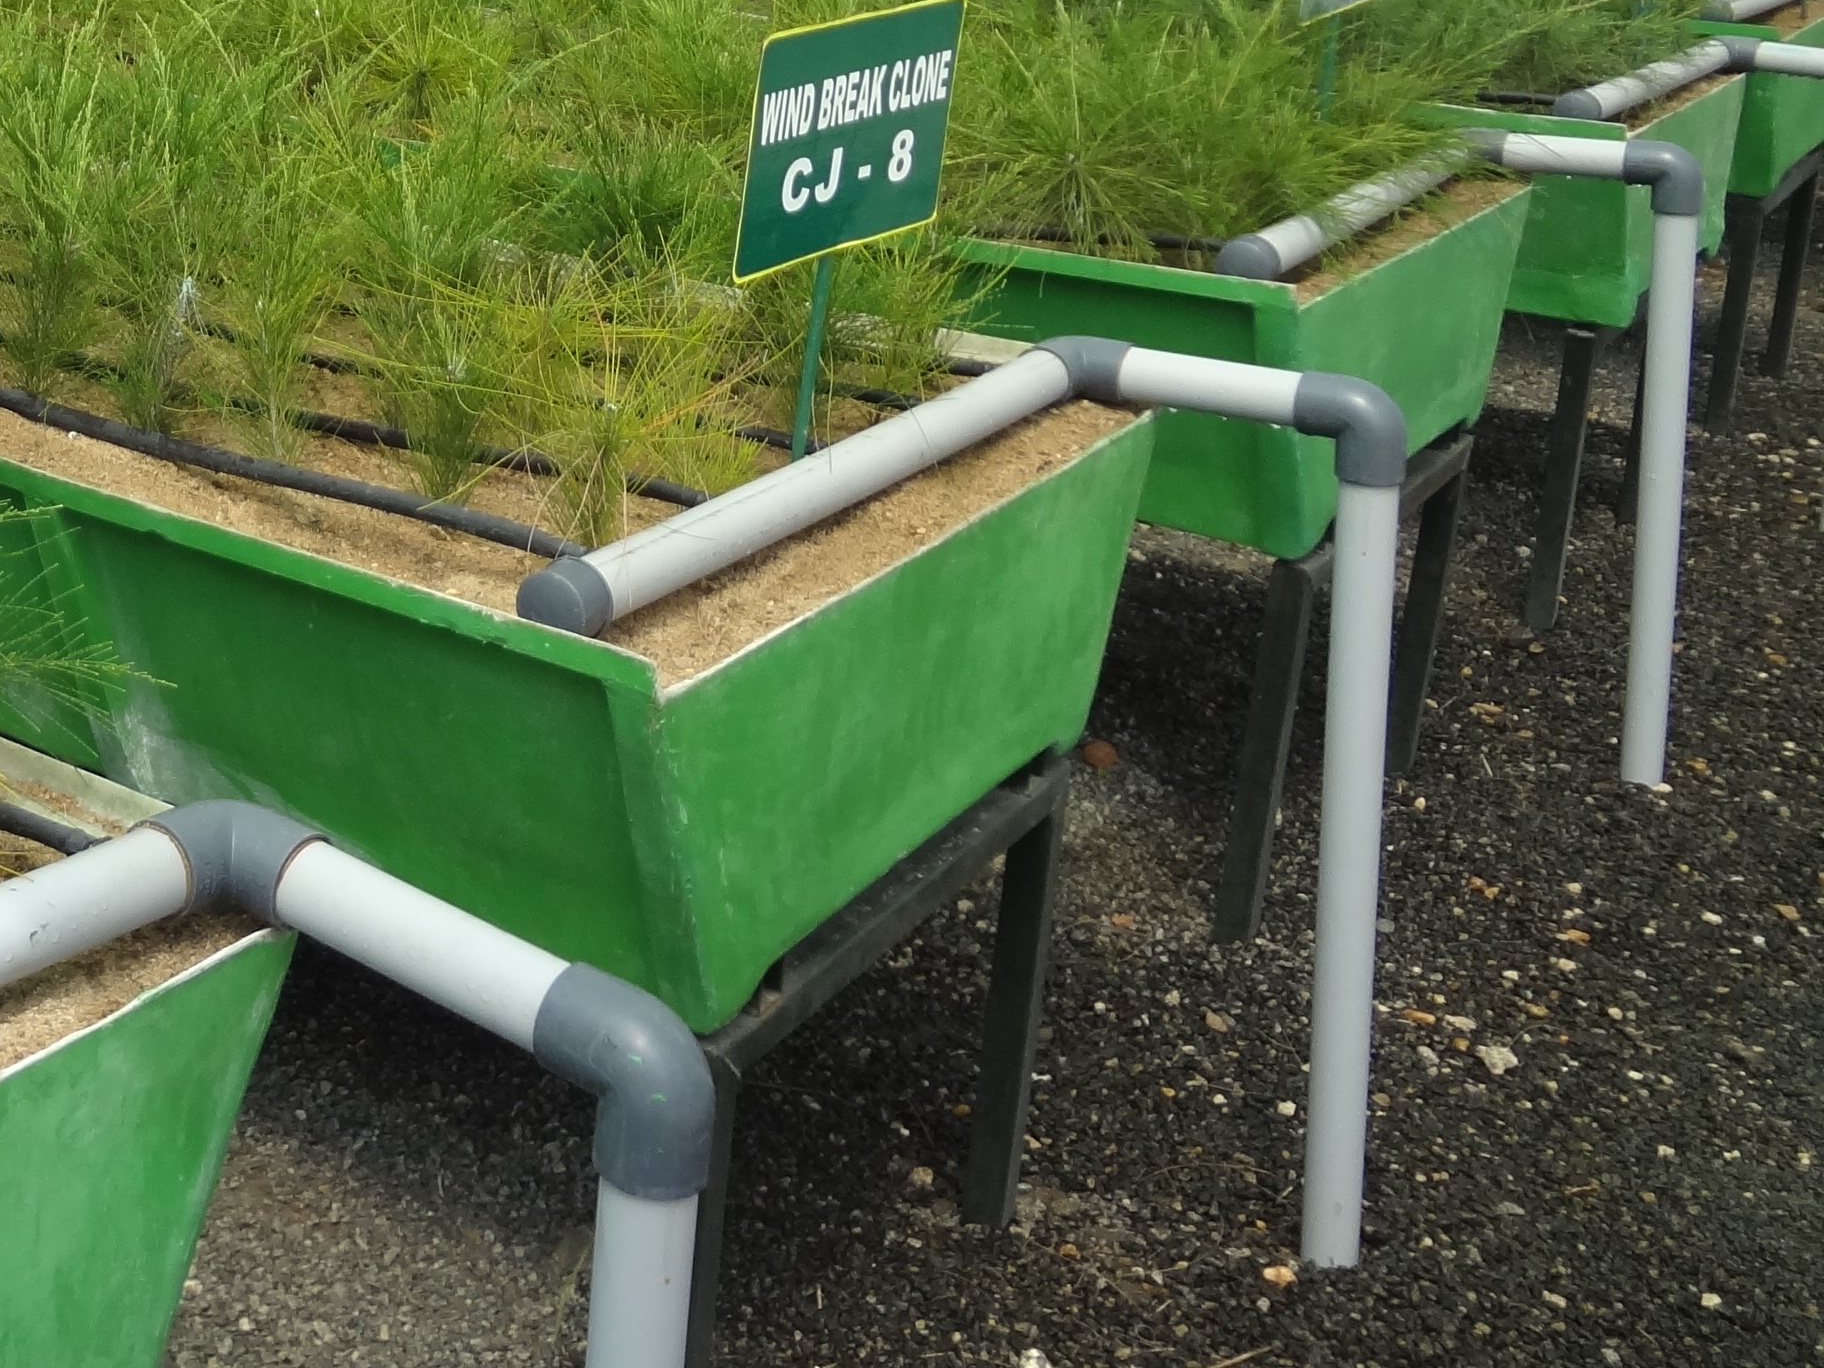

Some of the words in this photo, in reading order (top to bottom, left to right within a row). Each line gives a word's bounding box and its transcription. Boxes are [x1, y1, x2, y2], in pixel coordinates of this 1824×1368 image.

[761, 83, 815, 145] WIND
[817, 64, 887, 130] BREAK
[888, 49, 952, 112] CLONE
[782, 147, 843, 212] CJ
[888, 129, 914, 182] 8
